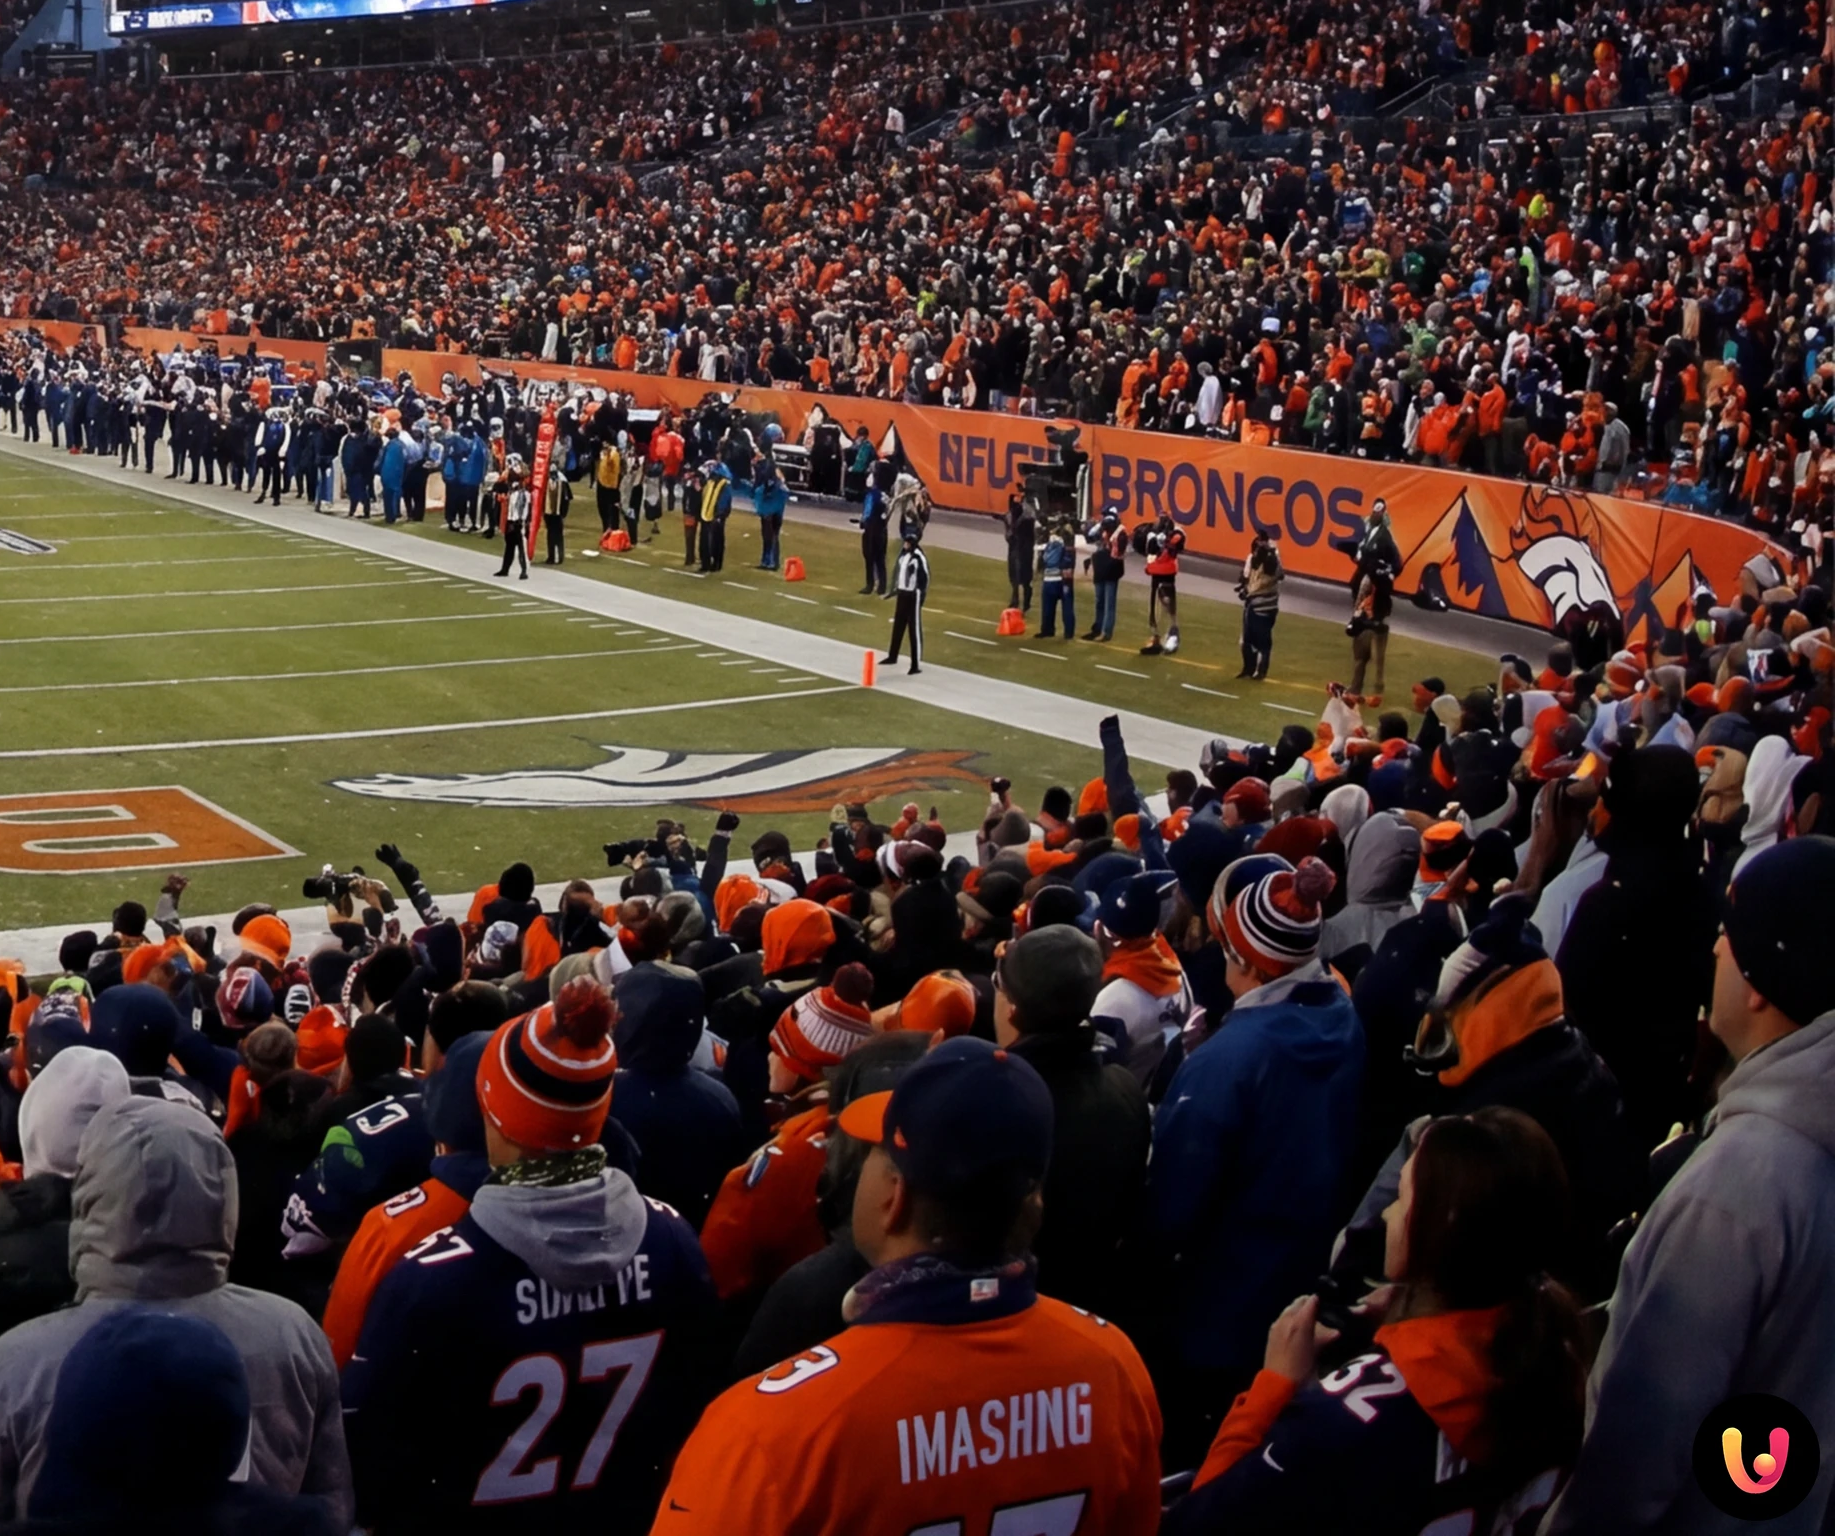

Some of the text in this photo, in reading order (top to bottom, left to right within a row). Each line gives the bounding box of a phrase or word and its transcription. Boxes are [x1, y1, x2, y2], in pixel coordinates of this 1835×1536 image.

[1101, 453, 1365, 551] BRONCOS
[471, 1326, 667, 1507] 27
[897, 1381, 1094, 1486] IMASHNG
